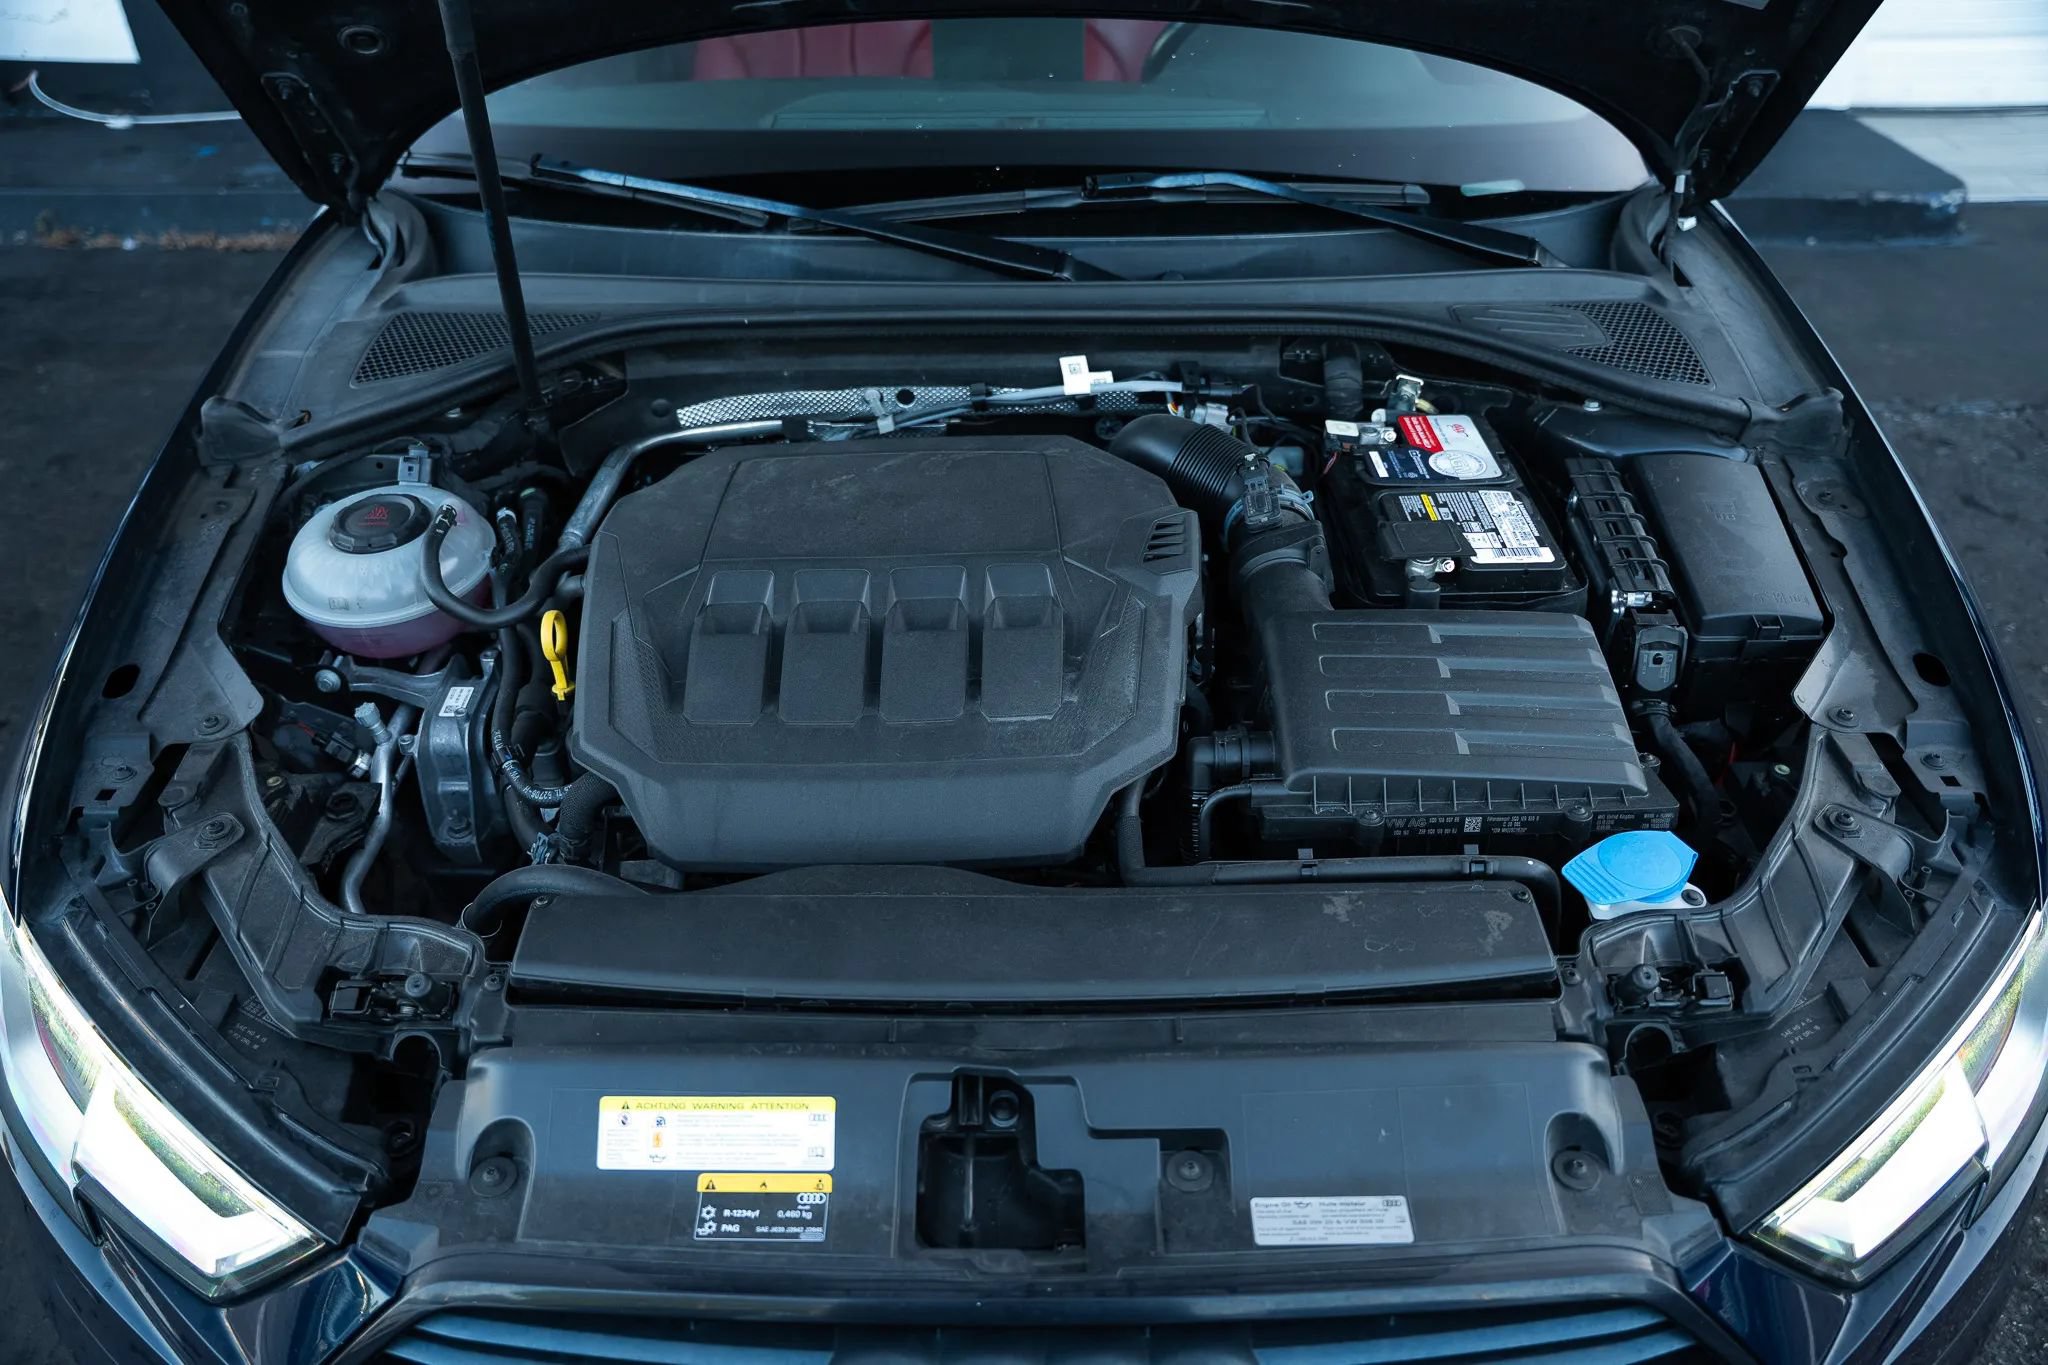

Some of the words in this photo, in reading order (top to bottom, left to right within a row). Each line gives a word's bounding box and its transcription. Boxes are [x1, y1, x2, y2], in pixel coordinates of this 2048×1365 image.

[1385, 818, 1407, 828] VW
[1408, 817, 1427, 828] AG
[635, 1102, 687, 1110] ACHTUNG
[692, 1102, 745, 1110] WARNING
[751, 1102, 809, 1110] ATTENTION
[722, 1209, 760, 1219] R-1234yf
[801, 1210, 813, 1220] kg
[720, 1224, 740, 1233] PAG
